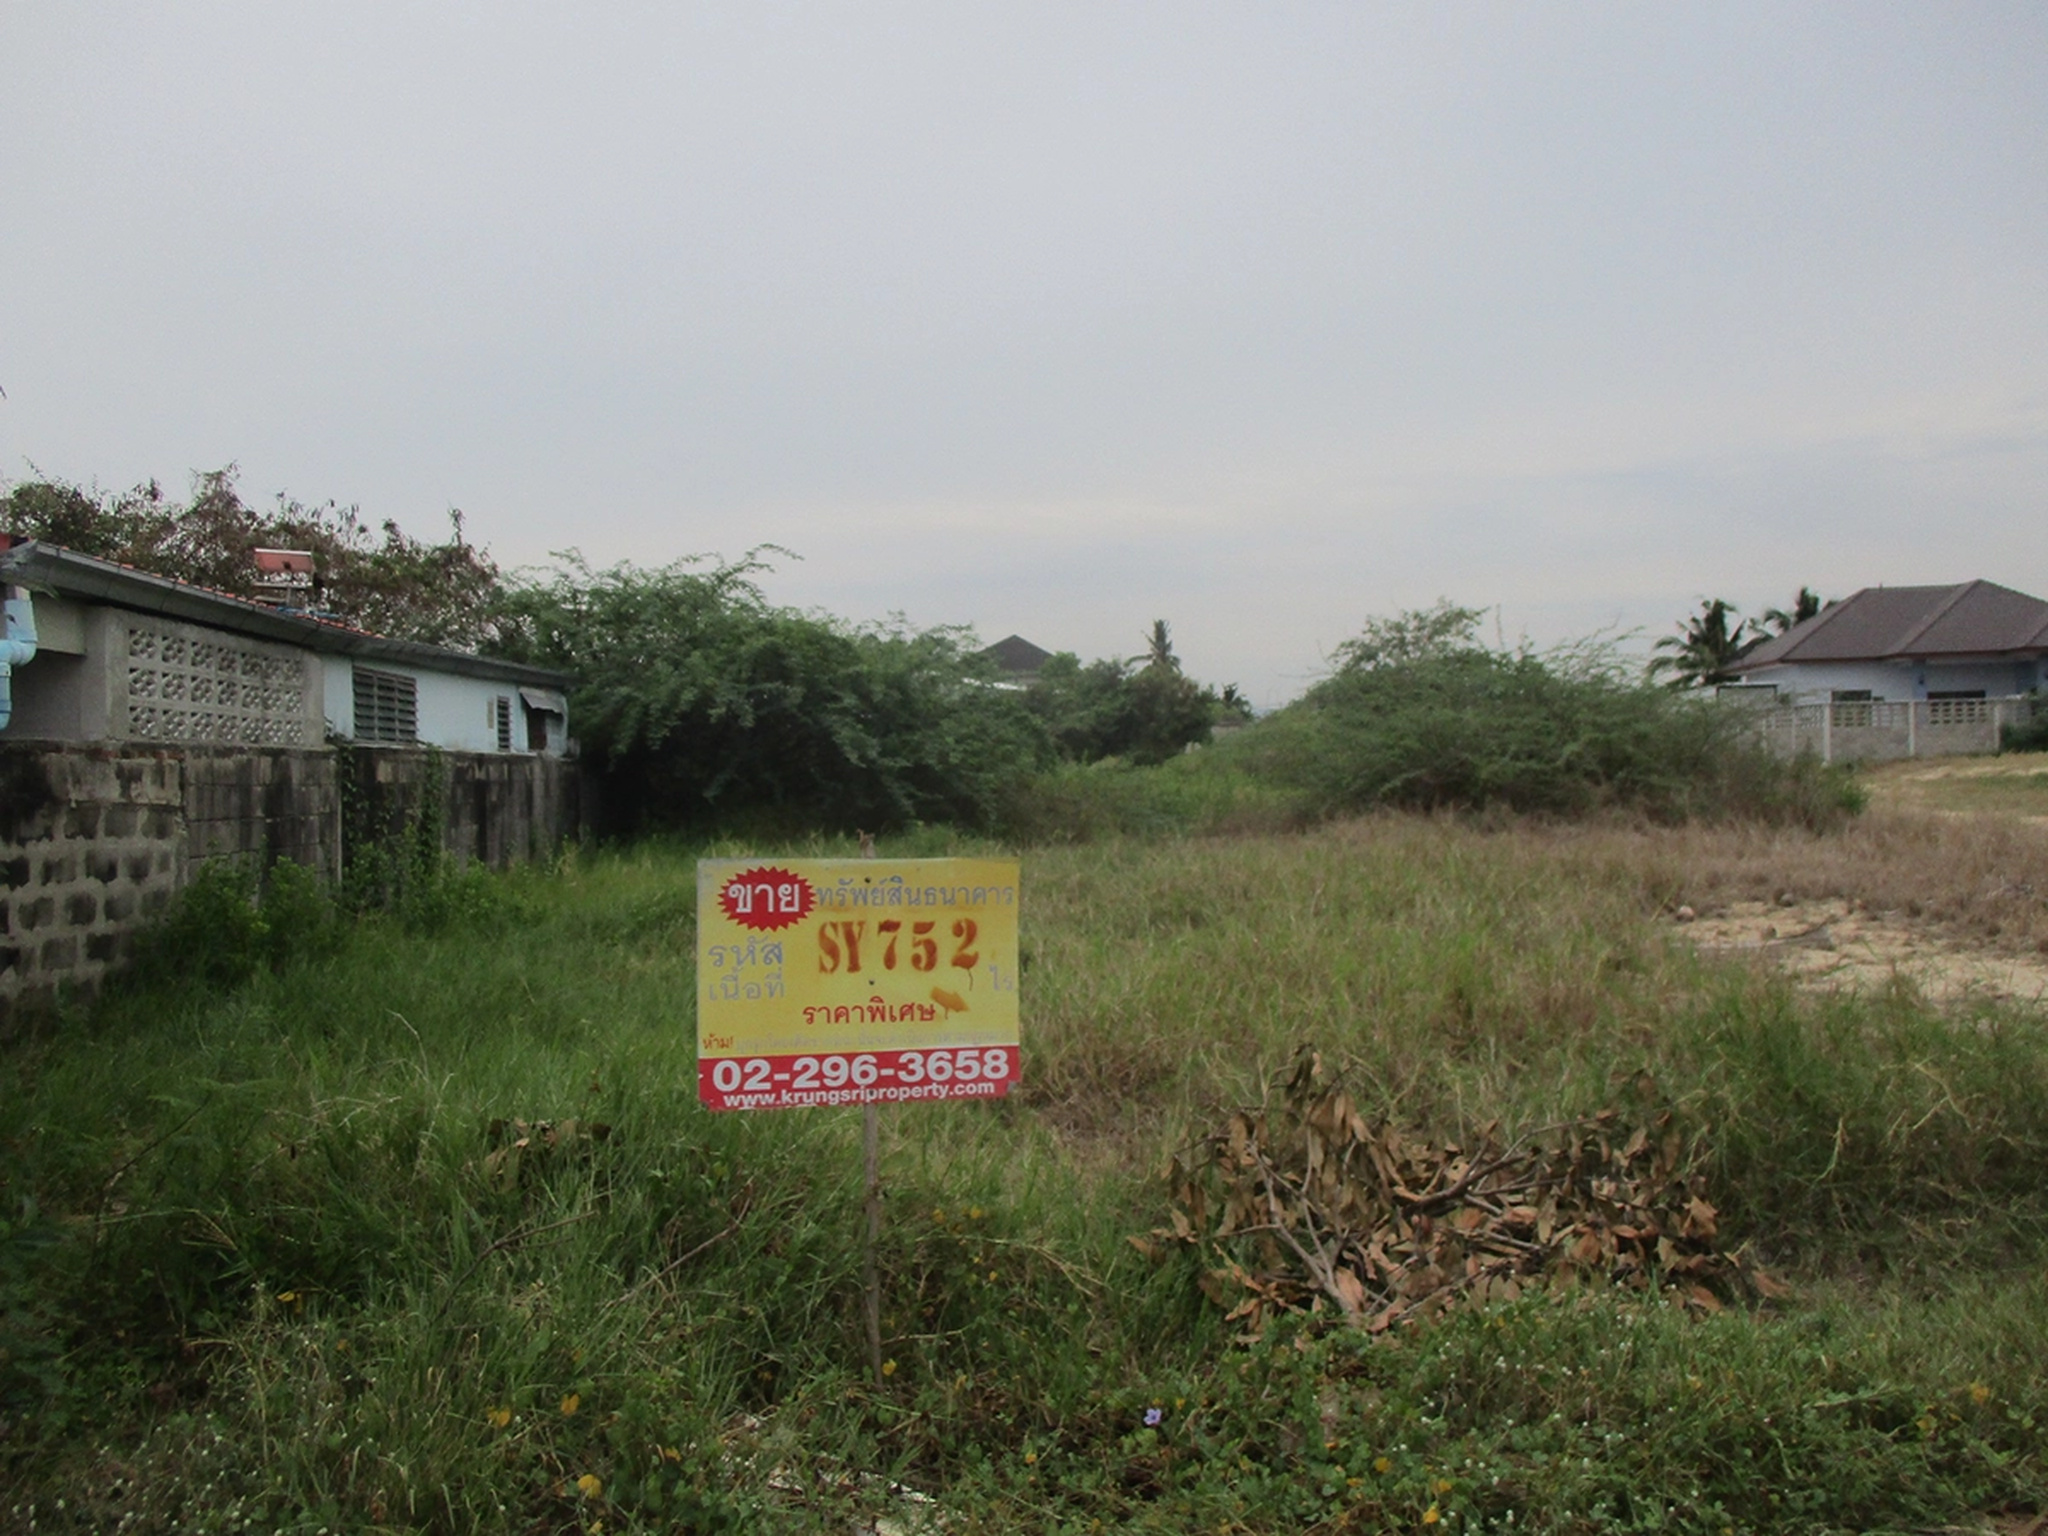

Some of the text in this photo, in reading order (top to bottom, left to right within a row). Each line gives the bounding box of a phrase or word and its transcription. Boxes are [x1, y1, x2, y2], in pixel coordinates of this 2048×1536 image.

[728, 883, 800, 913] ขาย
[816, 876, 1014, 906] ทรัพย์สินธนาคาร
[708, 935, 783, 967] รหัส
[803, 996, 936, 1024] ราคาพิเศษ
[713, 1049, 1009, 1092] 02-296-3658
[723, 1082, 995, 1107] www.krungsriproperty.com
